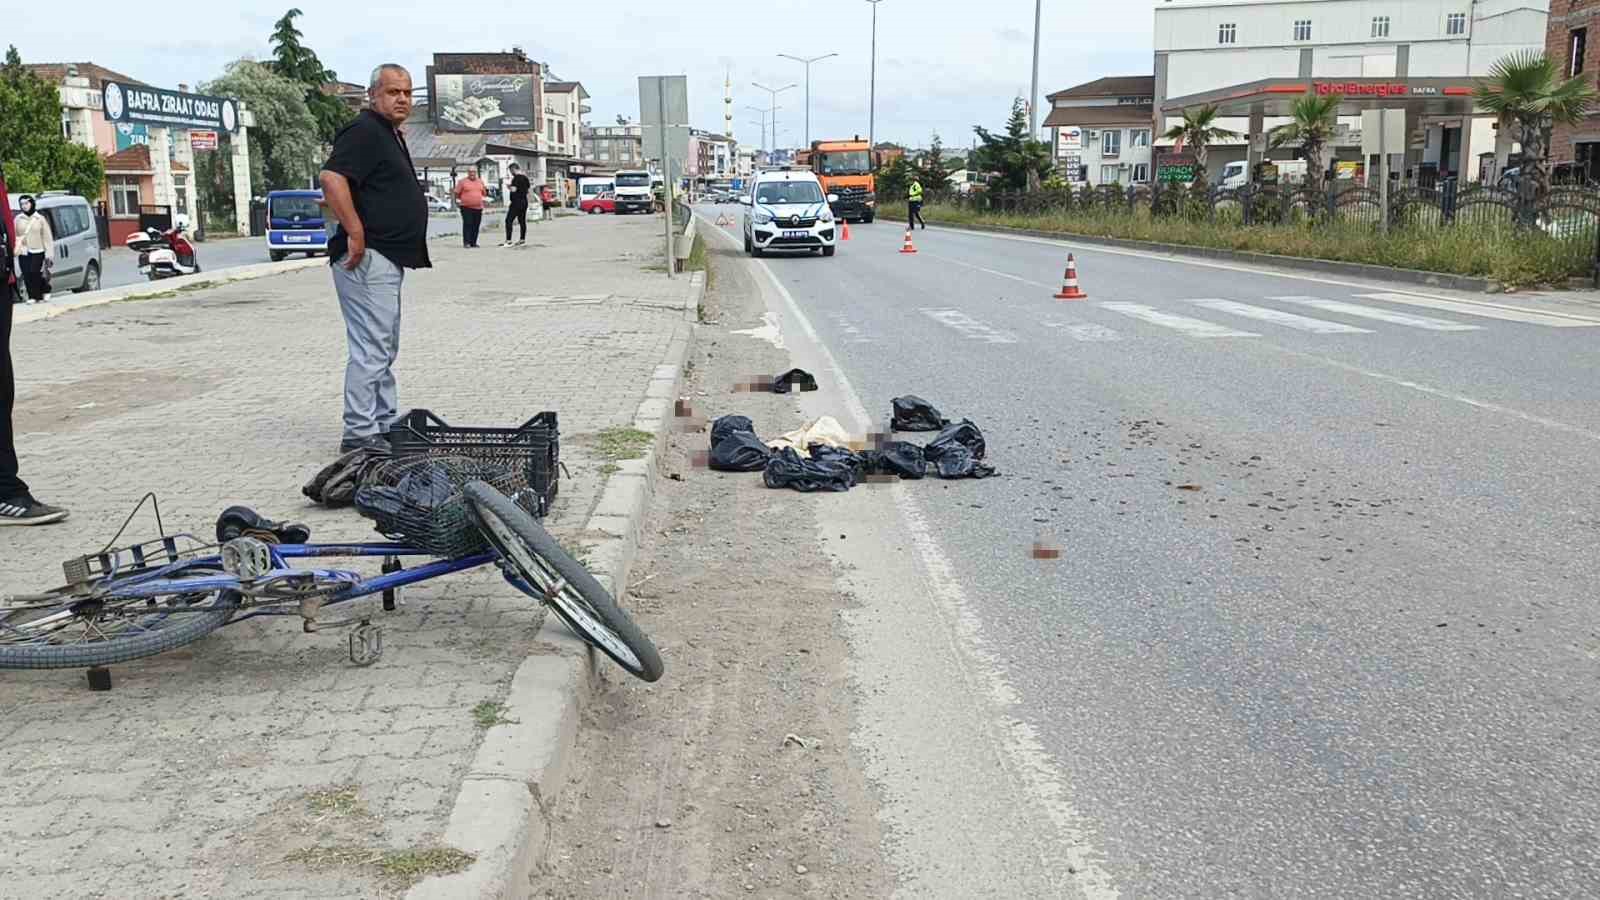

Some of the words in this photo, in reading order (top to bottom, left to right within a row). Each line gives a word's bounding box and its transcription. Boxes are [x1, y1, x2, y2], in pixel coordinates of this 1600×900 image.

[1314, 81, 1408, 96] TotalEnergies
[127, 89, 160, 111] BAFRA
[161, 94, 193, 115] ZİRAAT
[194, 99, 219, 118] ODASI
